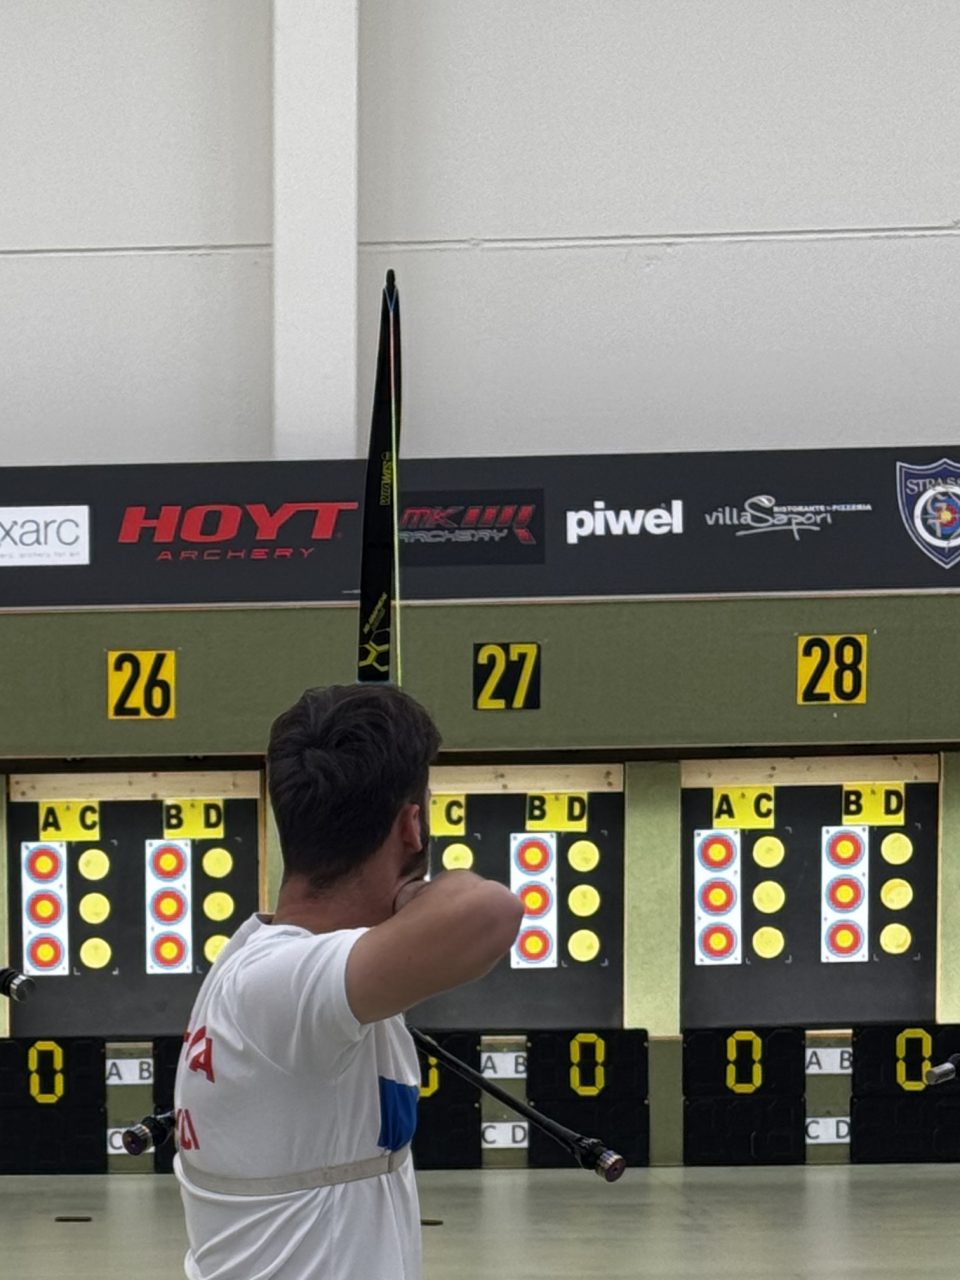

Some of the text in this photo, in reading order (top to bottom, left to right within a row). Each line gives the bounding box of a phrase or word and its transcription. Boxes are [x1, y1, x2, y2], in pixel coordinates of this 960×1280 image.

[906, 476, 960, 495] STRAS
[118, 502, 359, 543] HOYT
[567, 501, 683, 543] piwel
[157, 547, 314, 561] ARCHERY
[477, 644, 538, 709] 27
[802, 637, 861, 701] 28
[113, 653, 171, 716] 26
[444, 799, 464, 826] C
[528, 797, 587, 822] B D
[714, 792, 773, 819] A C
[844, 789, 904, 815] B D
[41, 806, 98, 832] A C
[165, 803, 222, 829] B D
[107, 1060, 152, 1081] A B
[481, 1055, 527, 1074] A B
[806, 1050, 853, 1072] A B
[108, 1129, 123, 1150] C
[482, 1125, 527, 1145] C D
[805, 1120, 851, 1141] C D
